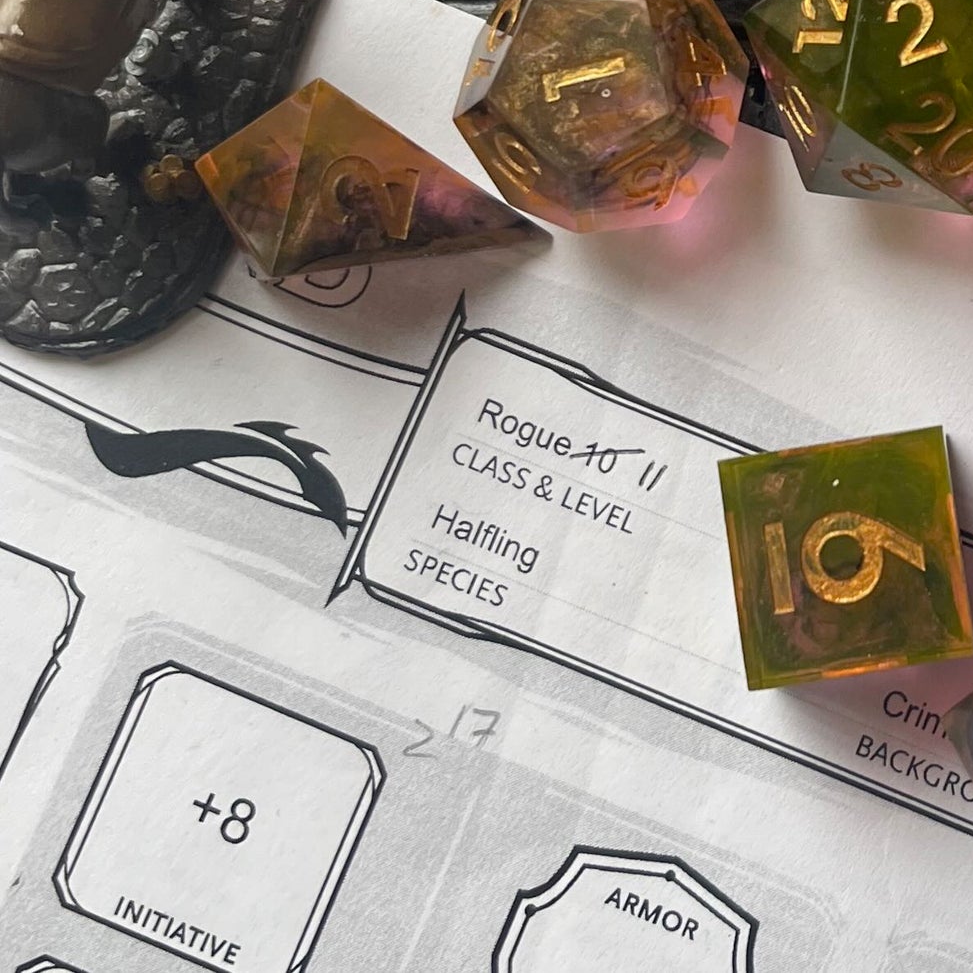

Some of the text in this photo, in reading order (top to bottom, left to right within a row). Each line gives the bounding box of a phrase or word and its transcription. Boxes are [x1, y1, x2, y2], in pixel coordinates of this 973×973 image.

[542, 57, 626, 103] 1
[477, 398, 572, 456] Rogue
[452, 443, 633, 534] CLASS & LEVEL
[431, 504, 540, 574] Halfling
[403, 549, 509, 607] SPECIES
[193, 792, 256, 844] +8
[114, 895, 241, 965] INITIATIVE
[604, 887, 699, 941] ARMOR
